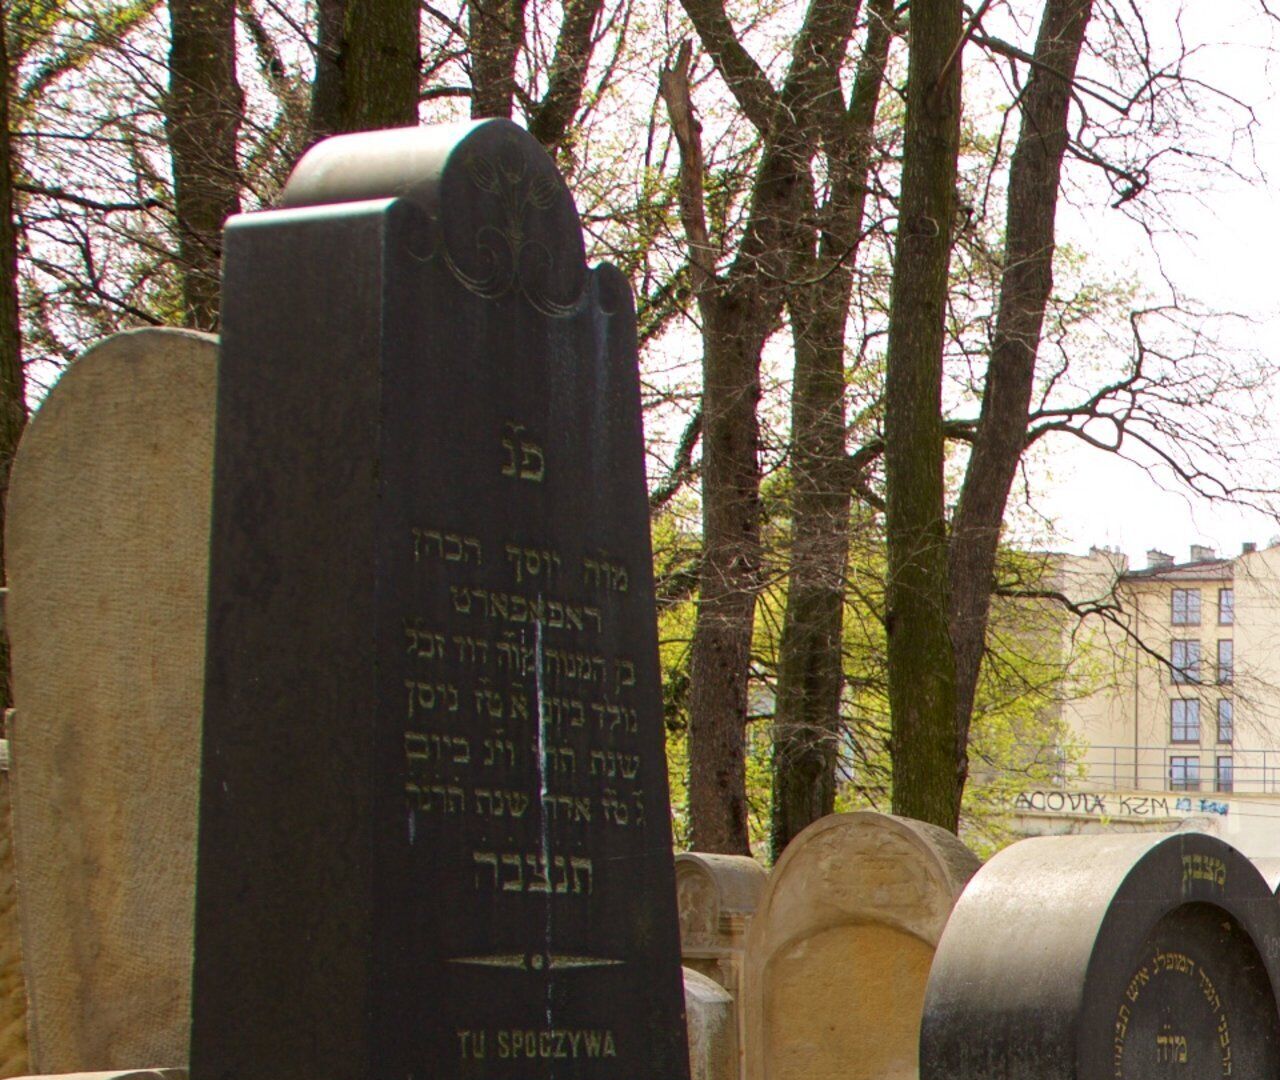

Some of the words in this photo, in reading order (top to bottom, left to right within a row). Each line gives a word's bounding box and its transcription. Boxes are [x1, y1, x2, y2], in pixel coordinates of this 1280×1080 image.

[411, 527, 482, 565] הכהן
[1015, 791, 1106, 813] ACOVIA
[457, 1030, 485, 1058] TU
[499, 1030, 616, 1058] SPOCZYWA
